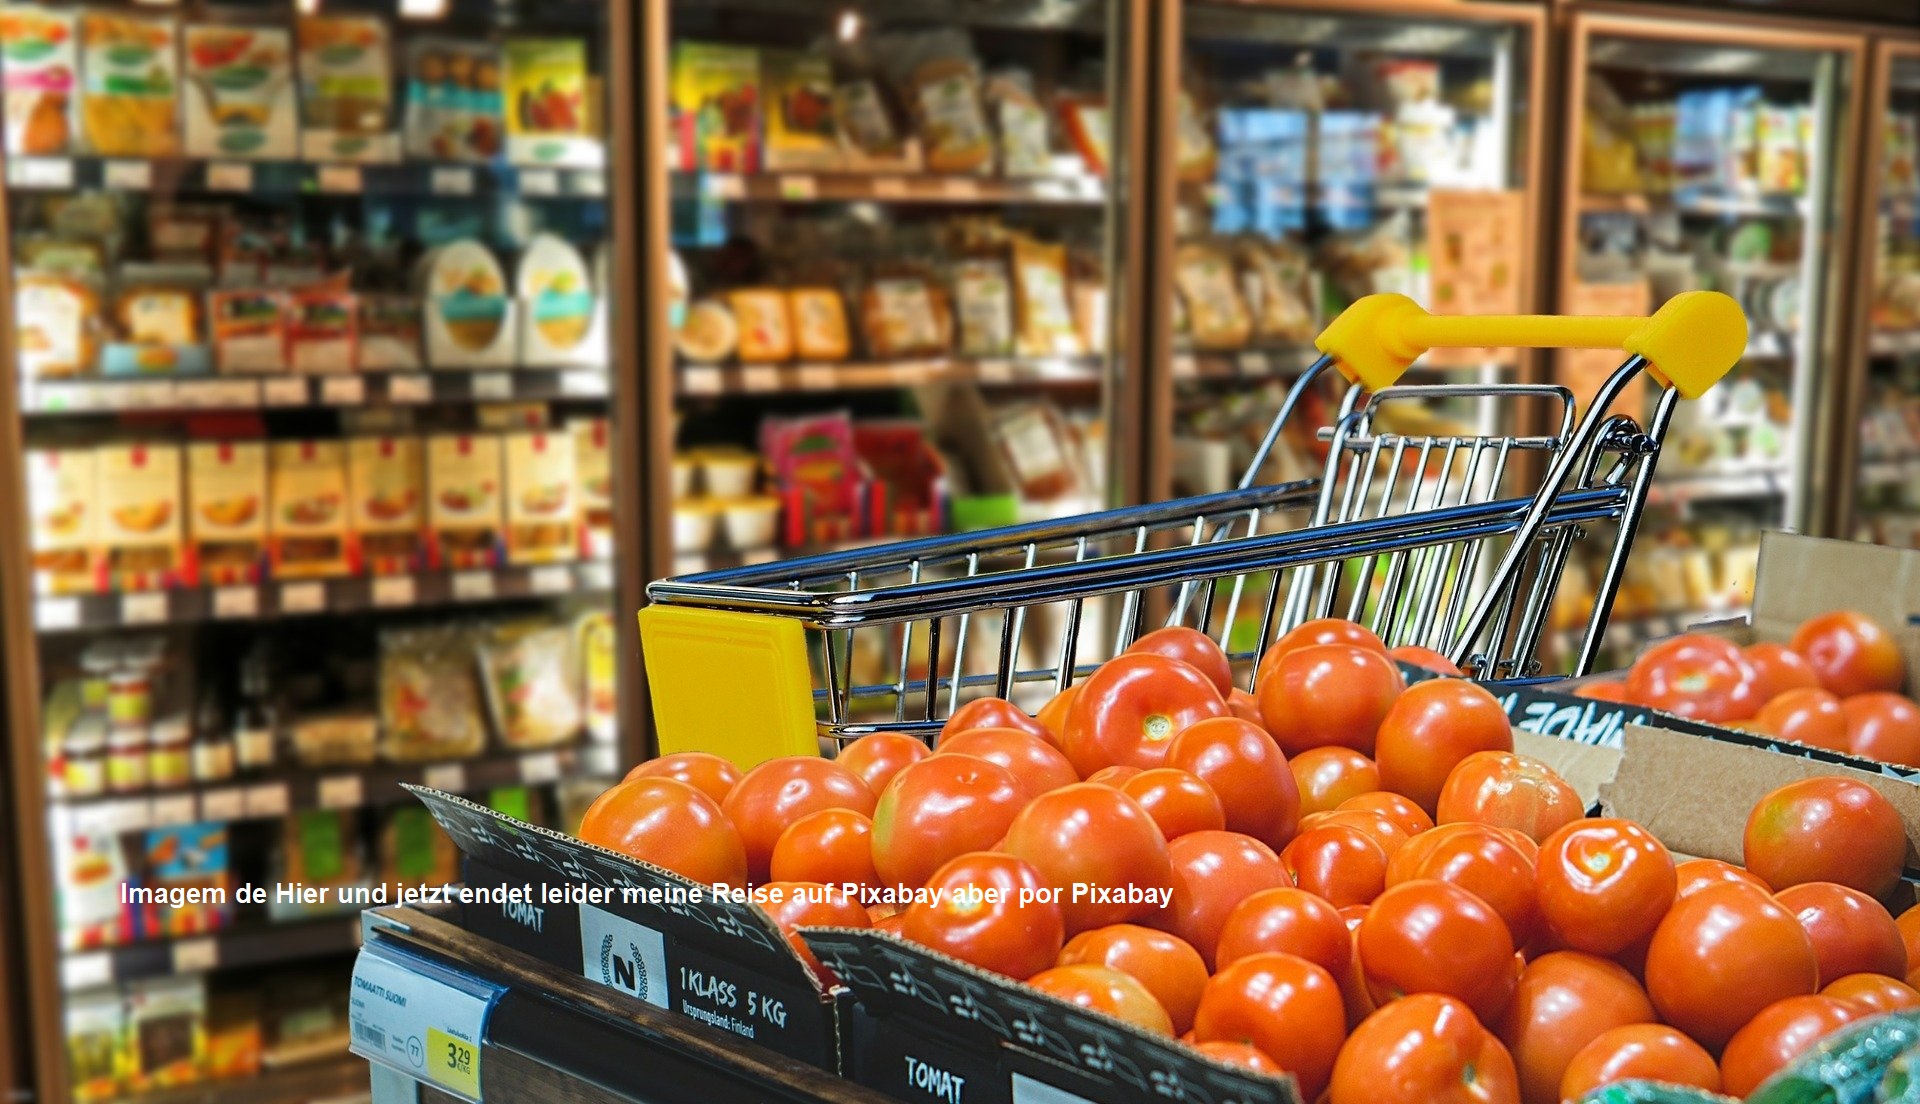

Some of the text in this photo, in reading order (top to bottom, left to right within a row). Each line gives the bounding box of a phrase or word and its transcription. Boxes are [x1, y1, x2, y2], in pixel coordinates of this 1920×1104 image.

[354, 976, 384, 997] TOMAATTI
[385, 990, 407, 1007] SUOMI
[689, 969, 737, 1008] KLASS
[748, 991, 757, 1015] 5
[762, 996, 787, 1028] KG
[683, 999, 754, 1039] Ursprungsland: Finland
[411, 1045, 419, 1057] 77
[904, 1055, 965, 1104] TOMAT
